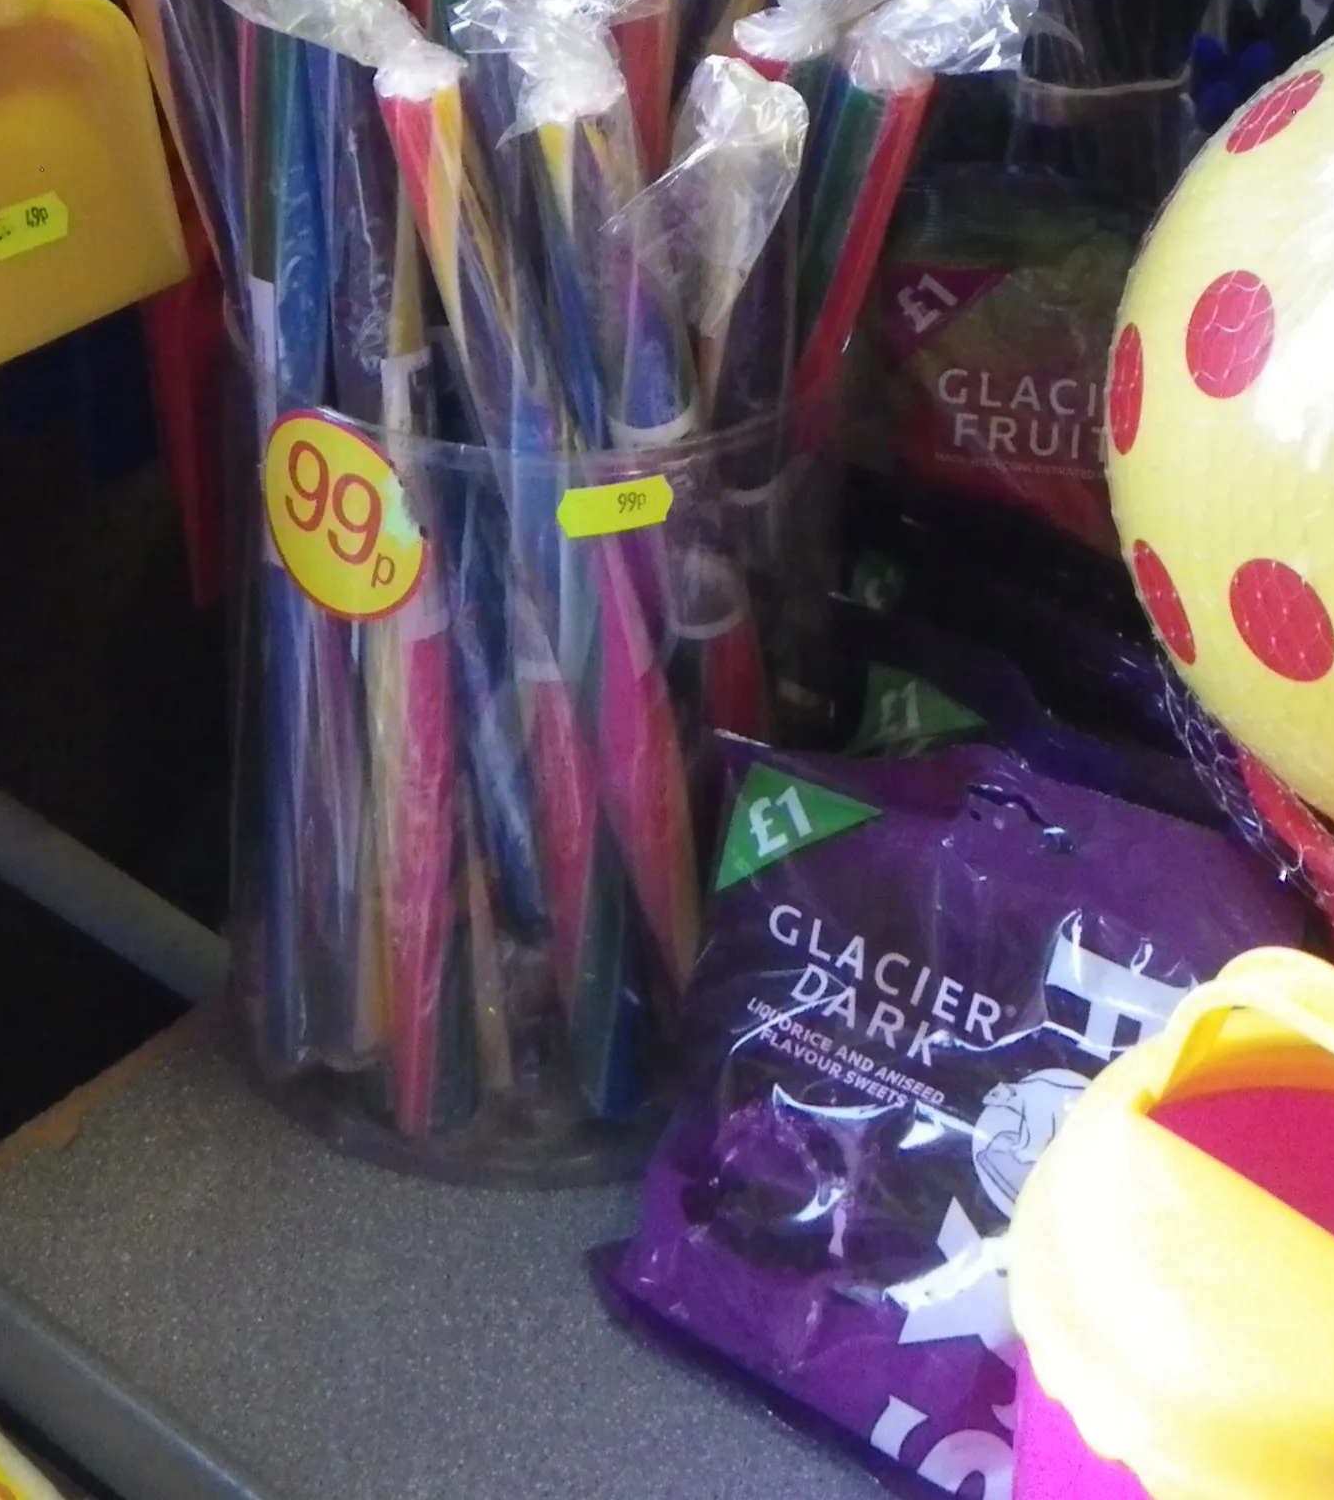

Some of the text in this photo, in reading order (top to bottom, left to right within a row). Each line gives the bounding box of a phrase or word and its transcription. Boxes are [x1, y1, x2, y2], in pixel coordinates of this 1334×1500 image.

[898, 272, 959, 334] £1
[937, 368, 1097, 417] GLACI
[285, 440, 396, 588] 99p
[873, 680, 921, 740] £1
[749, 785, 813, 858] £1
[769, 904, 1000, 1043] GLACIER
[746, 996, 946, 1106] LIQUORICE AND ANISEED
[790, 963, 933, 1067] DARK
[759, 1027, 909, 1109] FLAVOUR SWEETS
